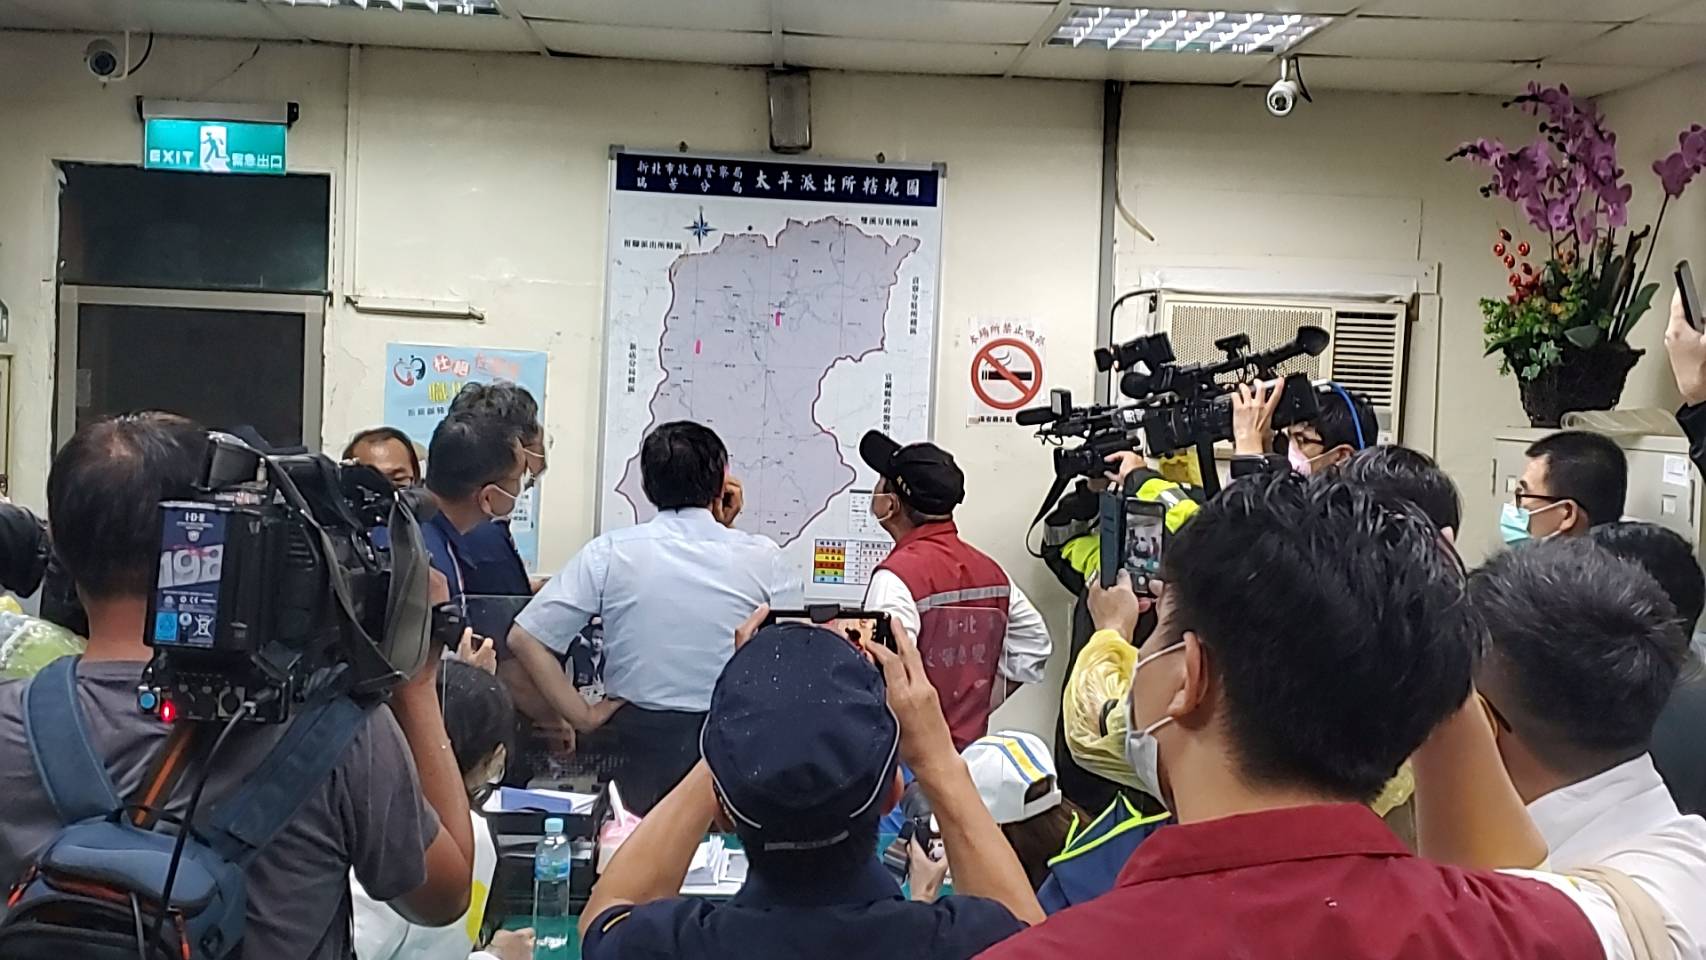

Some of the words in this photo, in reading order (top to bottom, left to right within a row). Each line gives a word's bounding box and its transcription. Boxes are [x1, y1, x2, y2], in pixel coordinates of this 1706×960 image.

[149, 149, 194, 165] EXIT
[231, 152, 283, 169] 緊急出口
[636, 160, 743, 179] 新北市政府警察局
[636, 176, 743, 194] 瑞芳分局
[755, 169, 920, 198] 太平派出所轄境圖
[158, 543, 224, 589] 198
